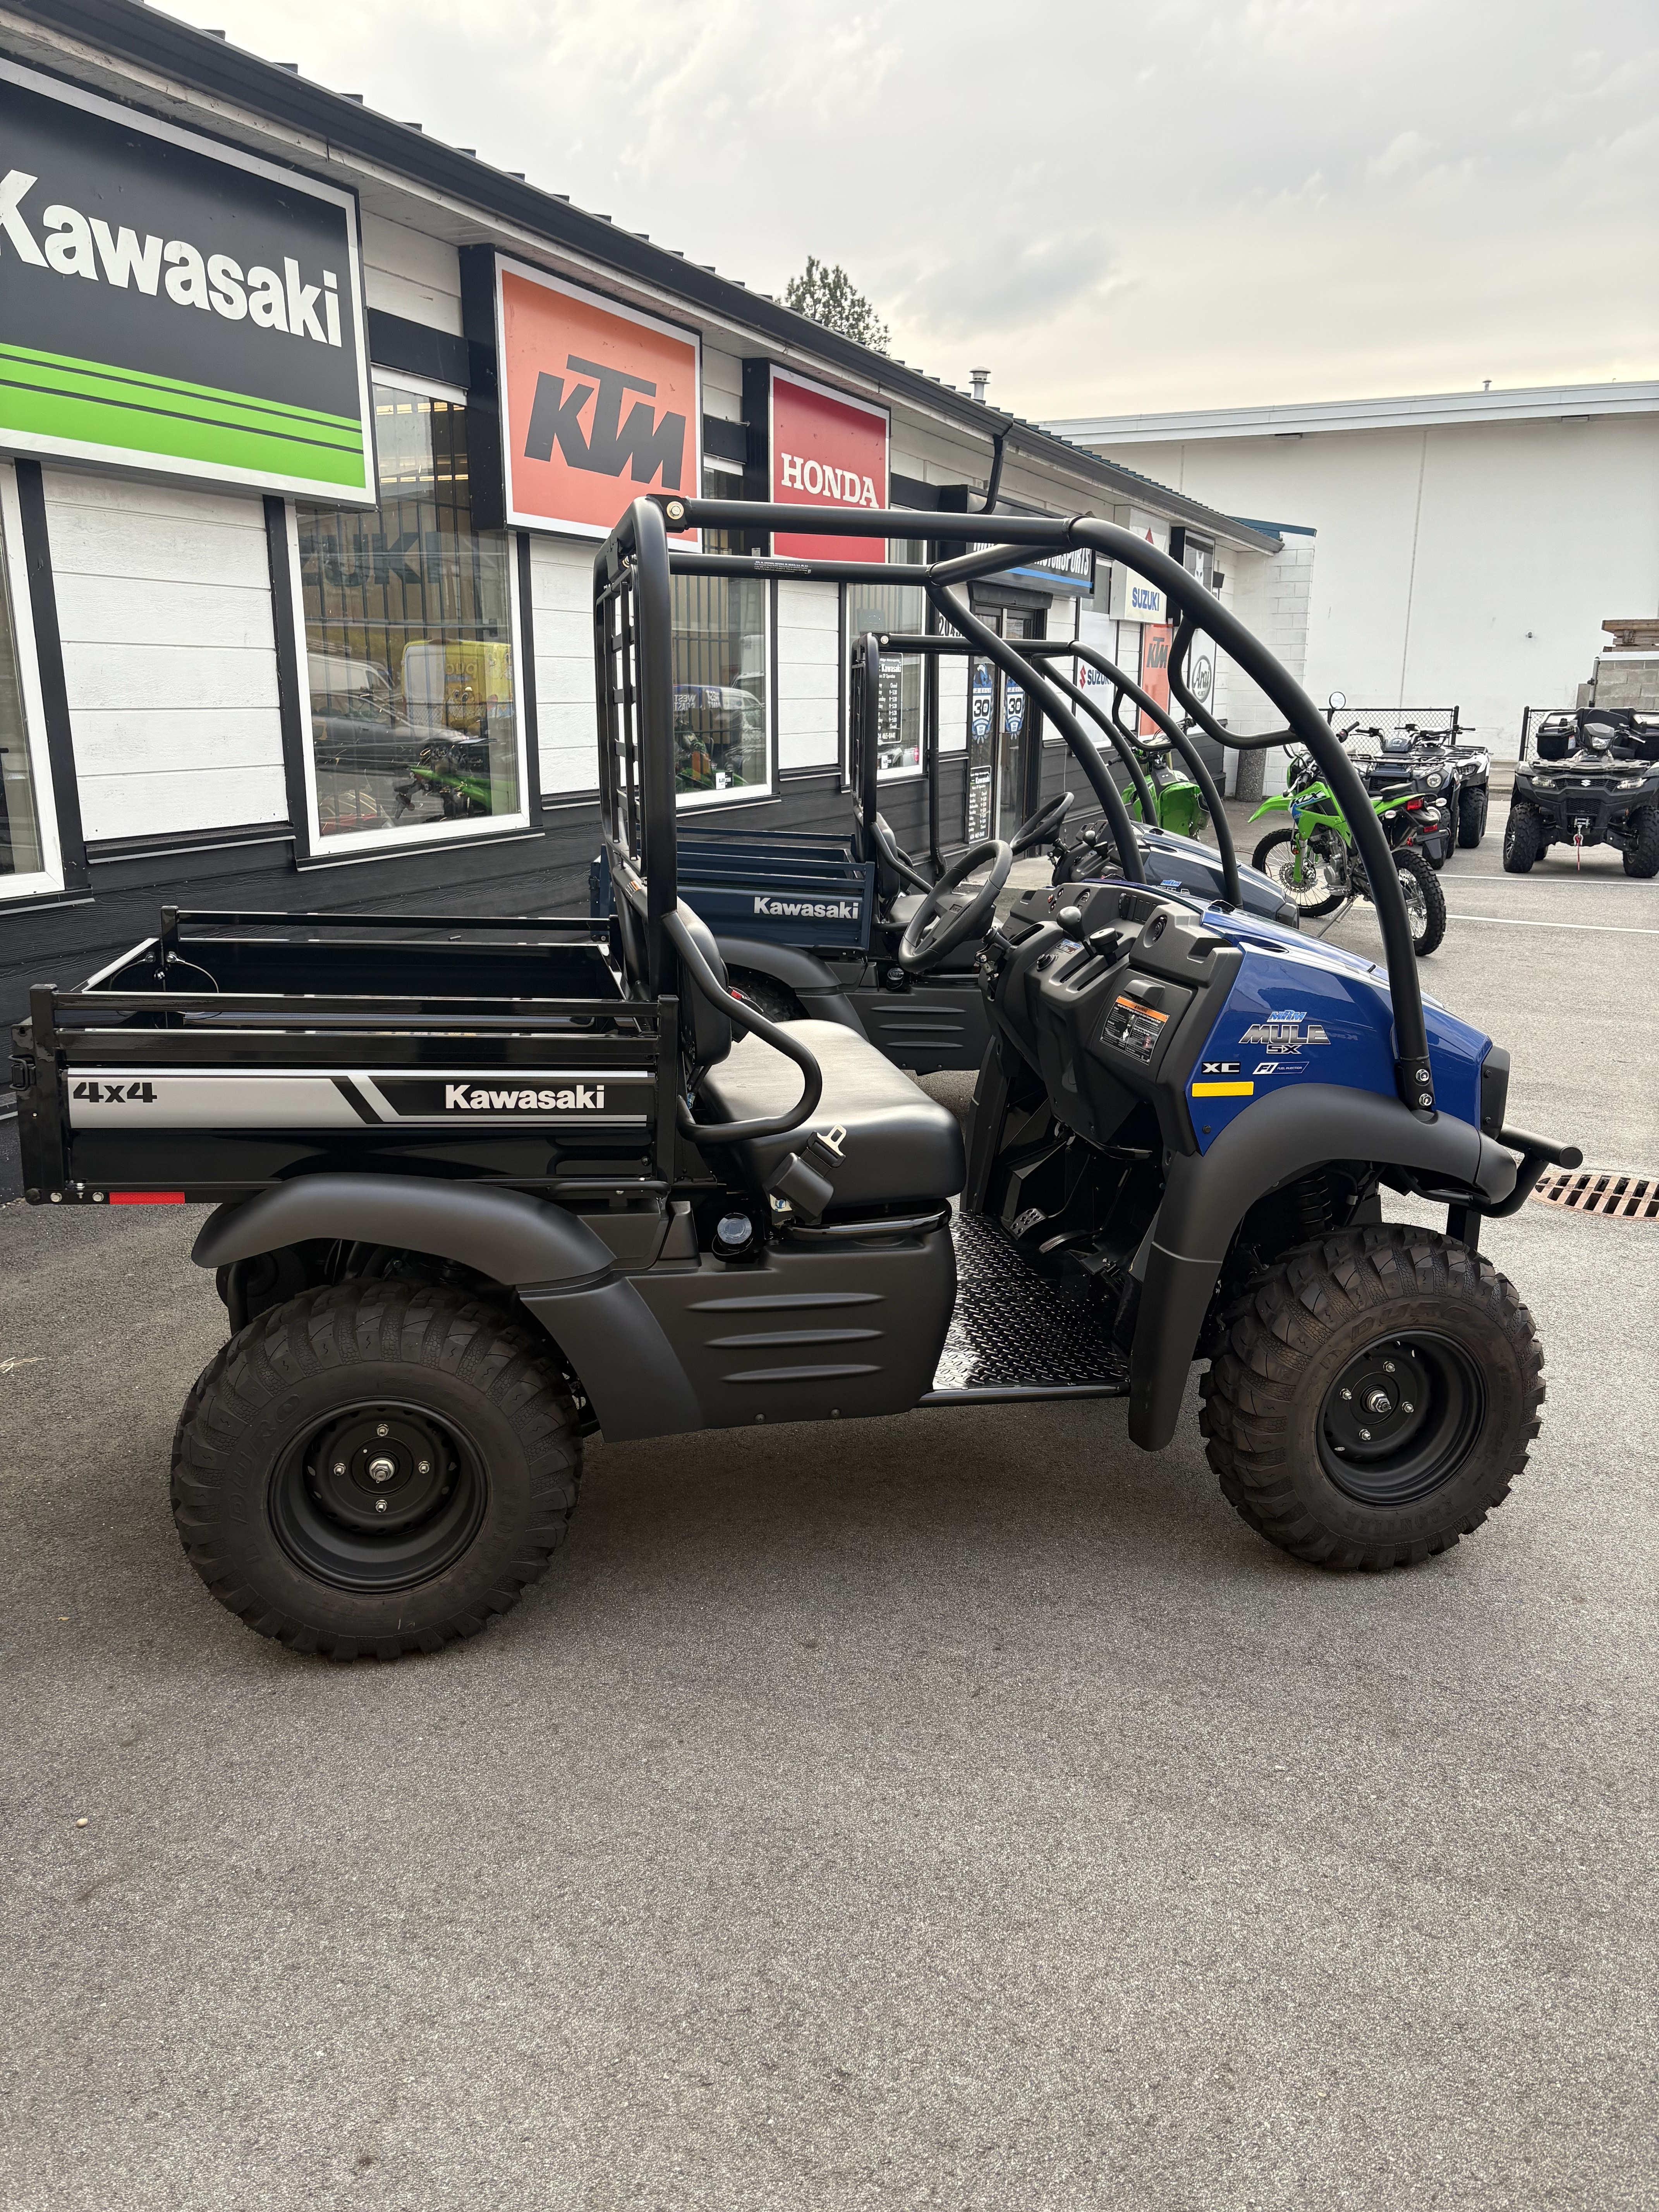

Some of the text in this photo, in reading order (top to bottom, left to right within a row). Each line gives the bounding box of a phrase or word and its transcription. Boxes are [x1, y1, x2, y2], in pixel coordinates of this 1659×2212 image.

[0, 170, 342, 347] Kawasaki
[524, 354, 686, 491] KTM
[781, 452, 879, 508] HONDA
[1132, 587, 1160, 611] SUZUKI
[1146, 637, 1169, 668] KTM
[1193, 661, 1209, 689] Arai
[974, 699, 989, 717] 30
[1008, 698, 1022, 715] 30
[754, 897, 859, 919] Kawasaki
[1267, 1010, 1307, 1022] MRM
[1238, 1024, 1331, 1044] MULE
[1266, 1044, 1302, 1054] SX
[1202, 1063, 1240, 1073] XC
[73, 1082, 157, 1103] 4x4
[446, 1085, 605, 1109] Kawasaki
[1351, 1302, 1468, 1342] DURO
[228, 1393, 301, 1525] DURO
